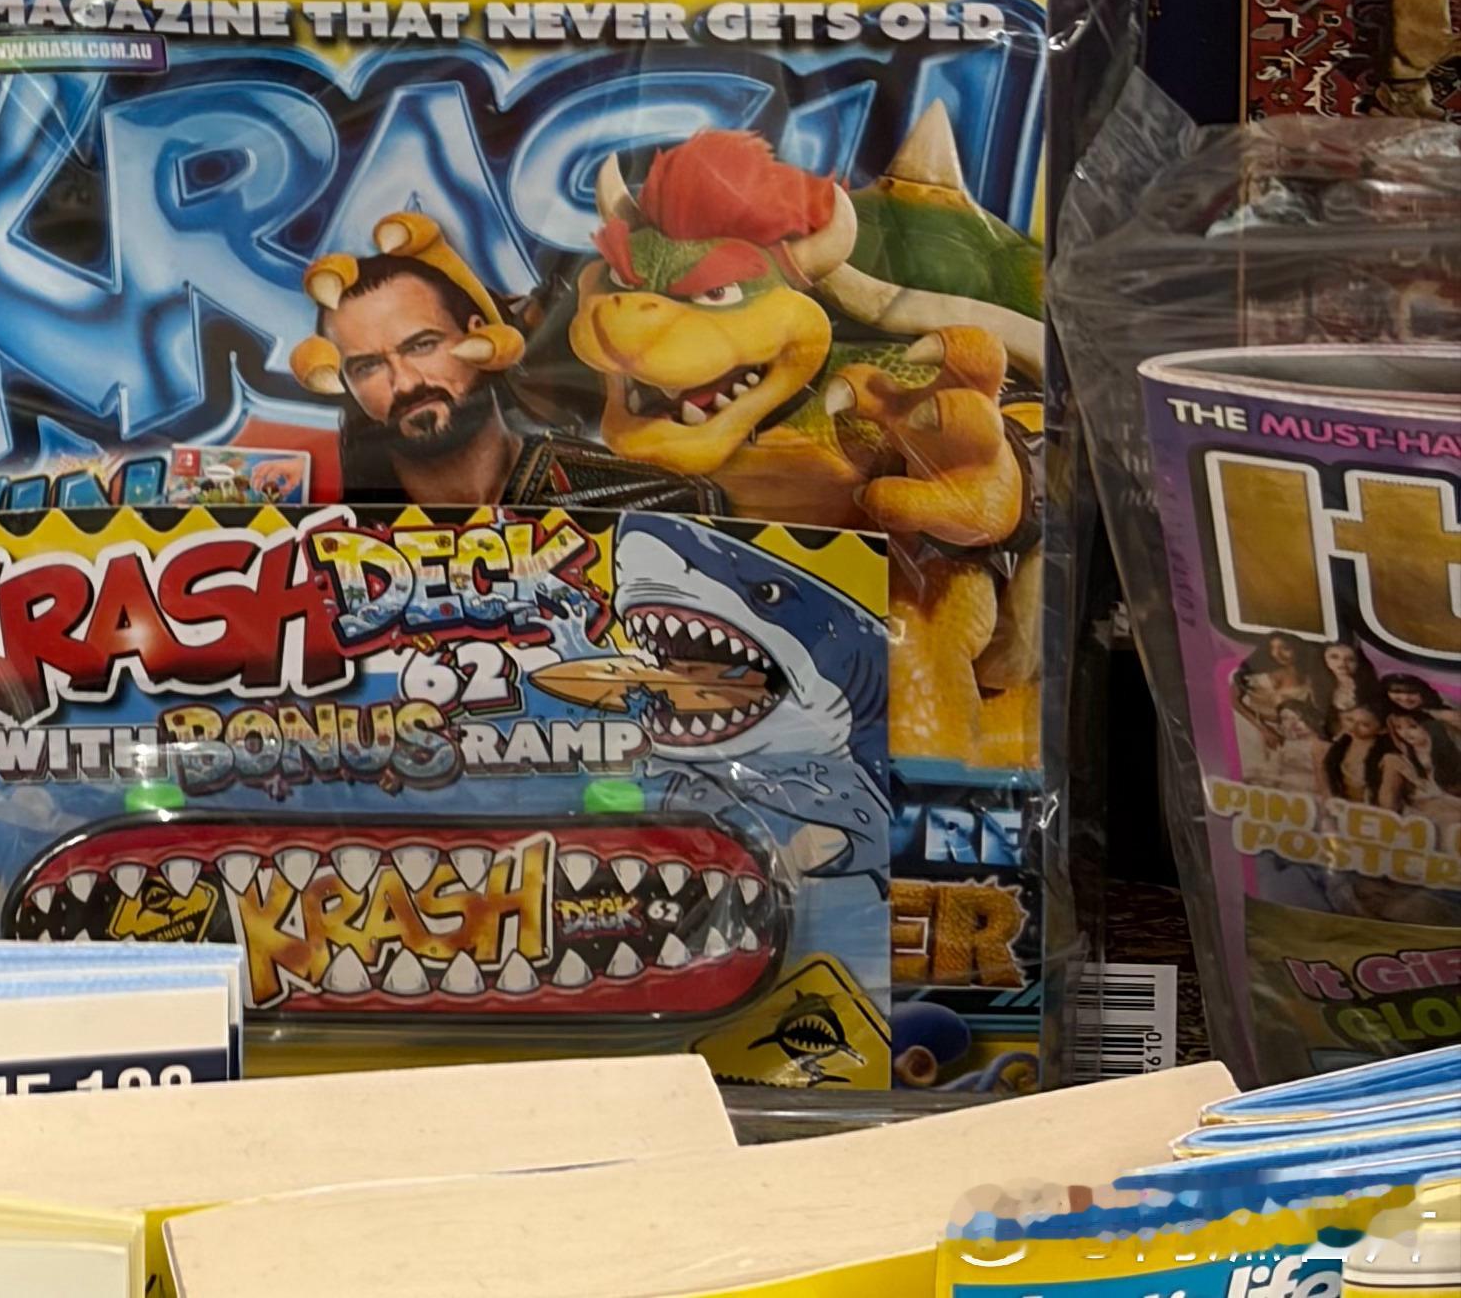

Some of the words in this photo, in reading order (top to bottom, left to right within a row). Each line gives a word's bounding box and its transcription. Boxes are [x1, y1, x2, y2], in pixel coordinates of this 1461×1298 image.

[295, 0, 470, 40] THAT
[485, 1, 693, 42] NEVER
[705, 1, 862, 42] GETS
[878, 2, 1006, 43] OLD
[1166, 397, 1248, 432] THE
[308, 515, 608, 657] DECK
[401, 642, 525, 714] 62
[156, 703, 456, 795] BONUS
[460, 720, 650, 776] RAMP
